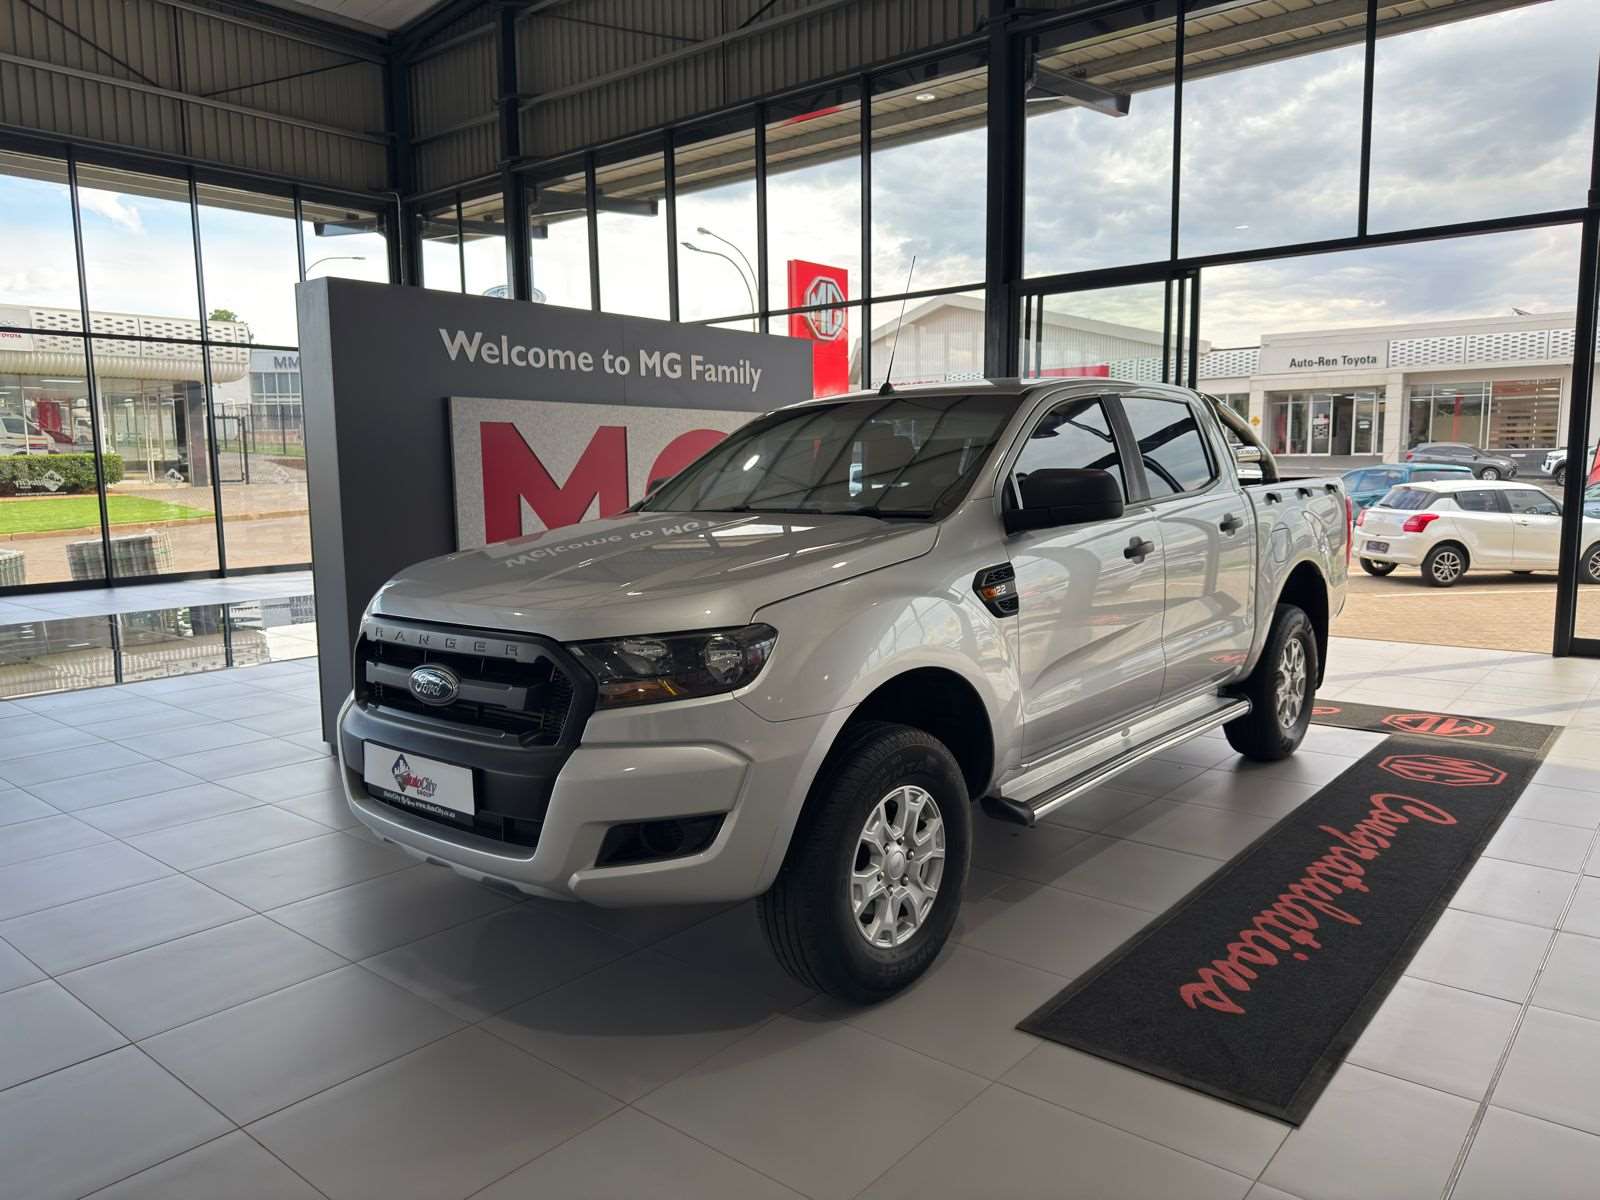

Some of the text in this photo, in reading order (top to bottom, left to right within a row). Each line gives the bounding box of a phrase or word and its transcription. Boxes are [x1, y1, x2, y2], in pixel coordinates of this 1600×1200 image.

[809, 279, 845, 336] MG
[438, 328, 762, 393] Welcome to MG Family
[1289, 354, 1377, 368] Auto-Ren Toyota
[480, 421, 728, 545] M
[375, 626, 518, 657] RANGER
[404, 771, 437, 792] AutoCity
[1180, 793, 1456, 1015] Congratulations
